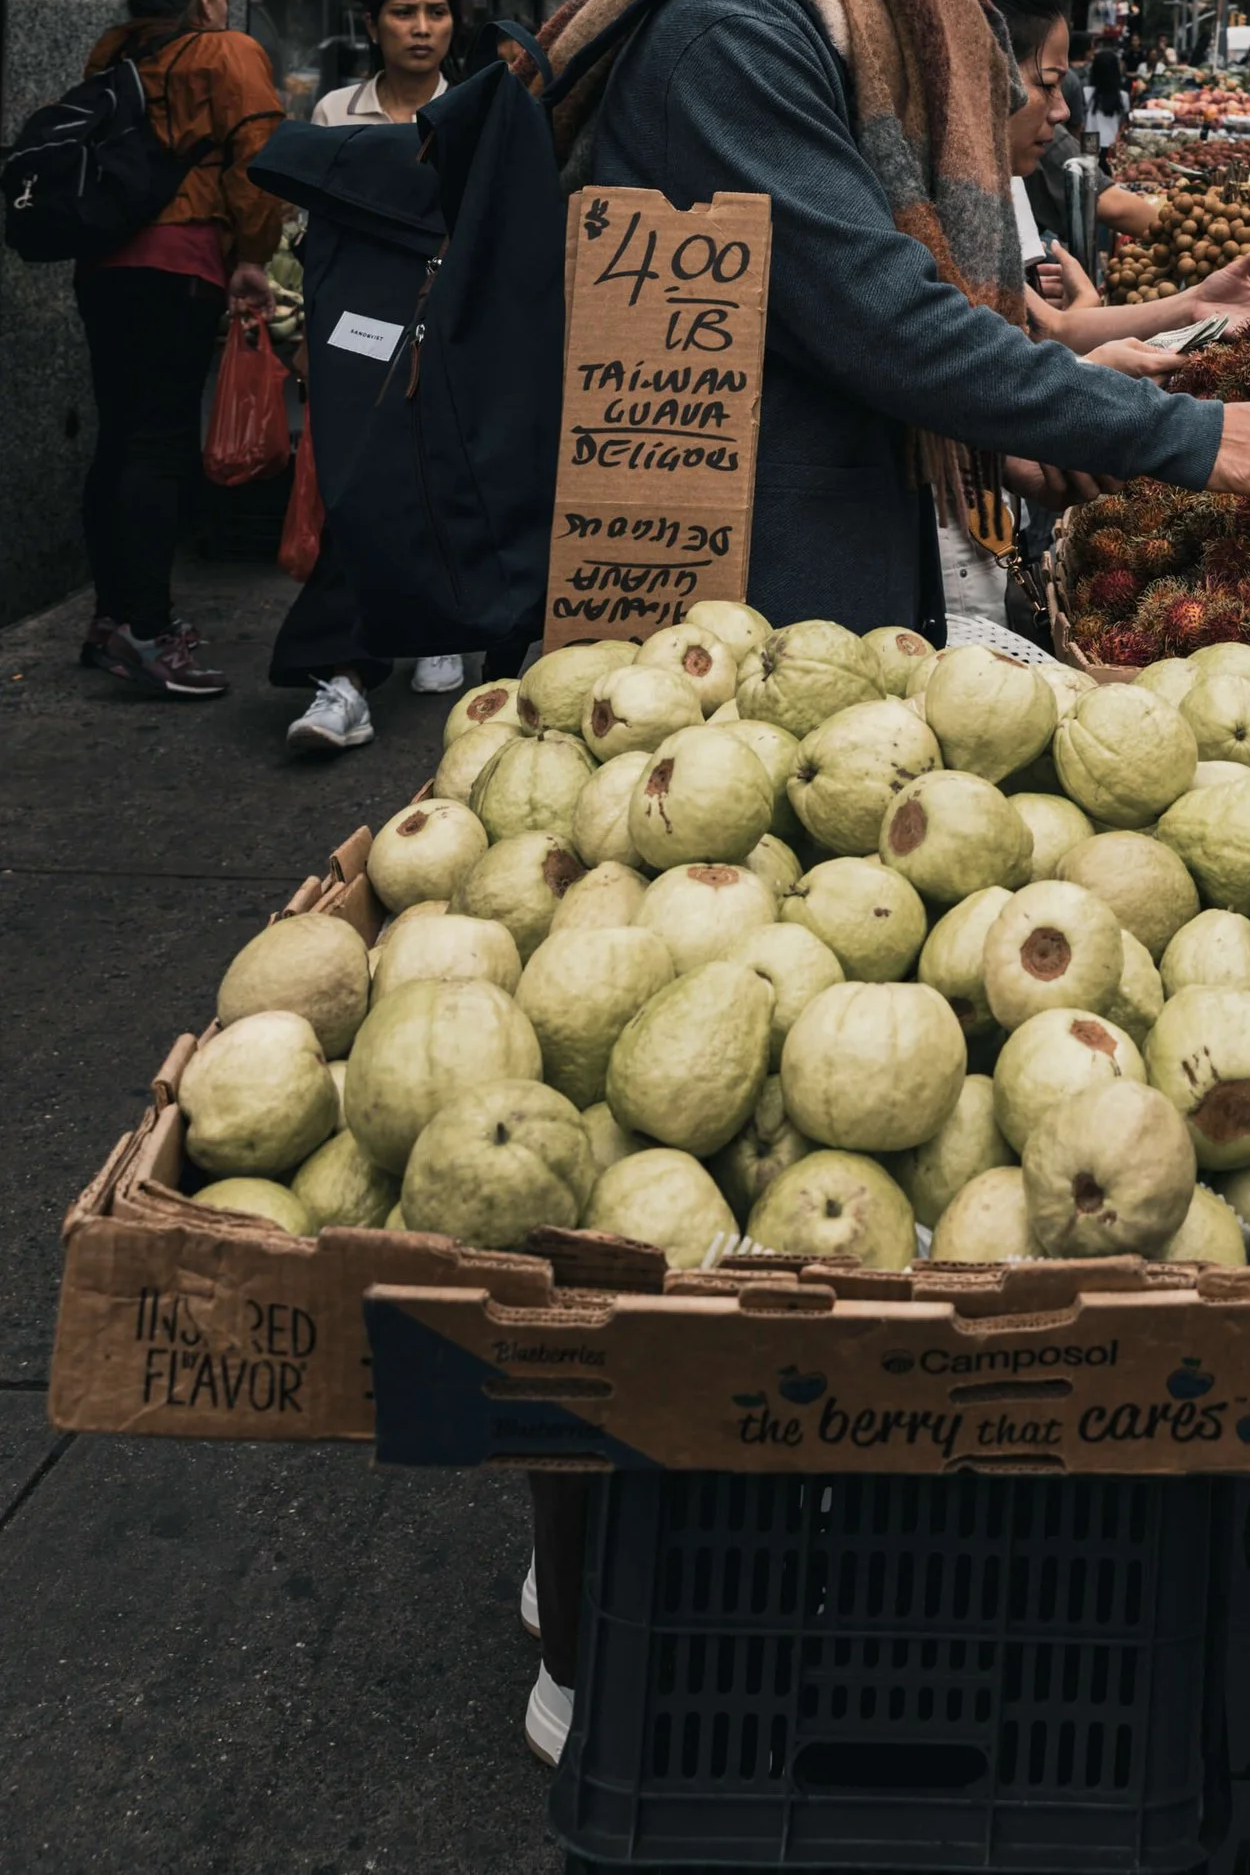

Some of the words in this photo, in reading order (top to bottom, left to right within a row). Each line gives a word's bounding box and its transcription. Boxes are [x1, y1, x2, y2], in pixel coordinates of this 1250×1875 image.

[604, 398, 731, 428] GUAVA
[565, 567, 698, 597] GUAVA
[136, 1287, 317, 1359] INSRED
[143, 1348, 304, 1413] FLAVOR
[919, 1339, 1119, 1375] Camposol
[739, 1399, 804, 1447] the
[819, 1397, 963, 1459] berry
[977, 1414, 1062, 1446] that
[1078, 1400, 1228, 1444] cares
